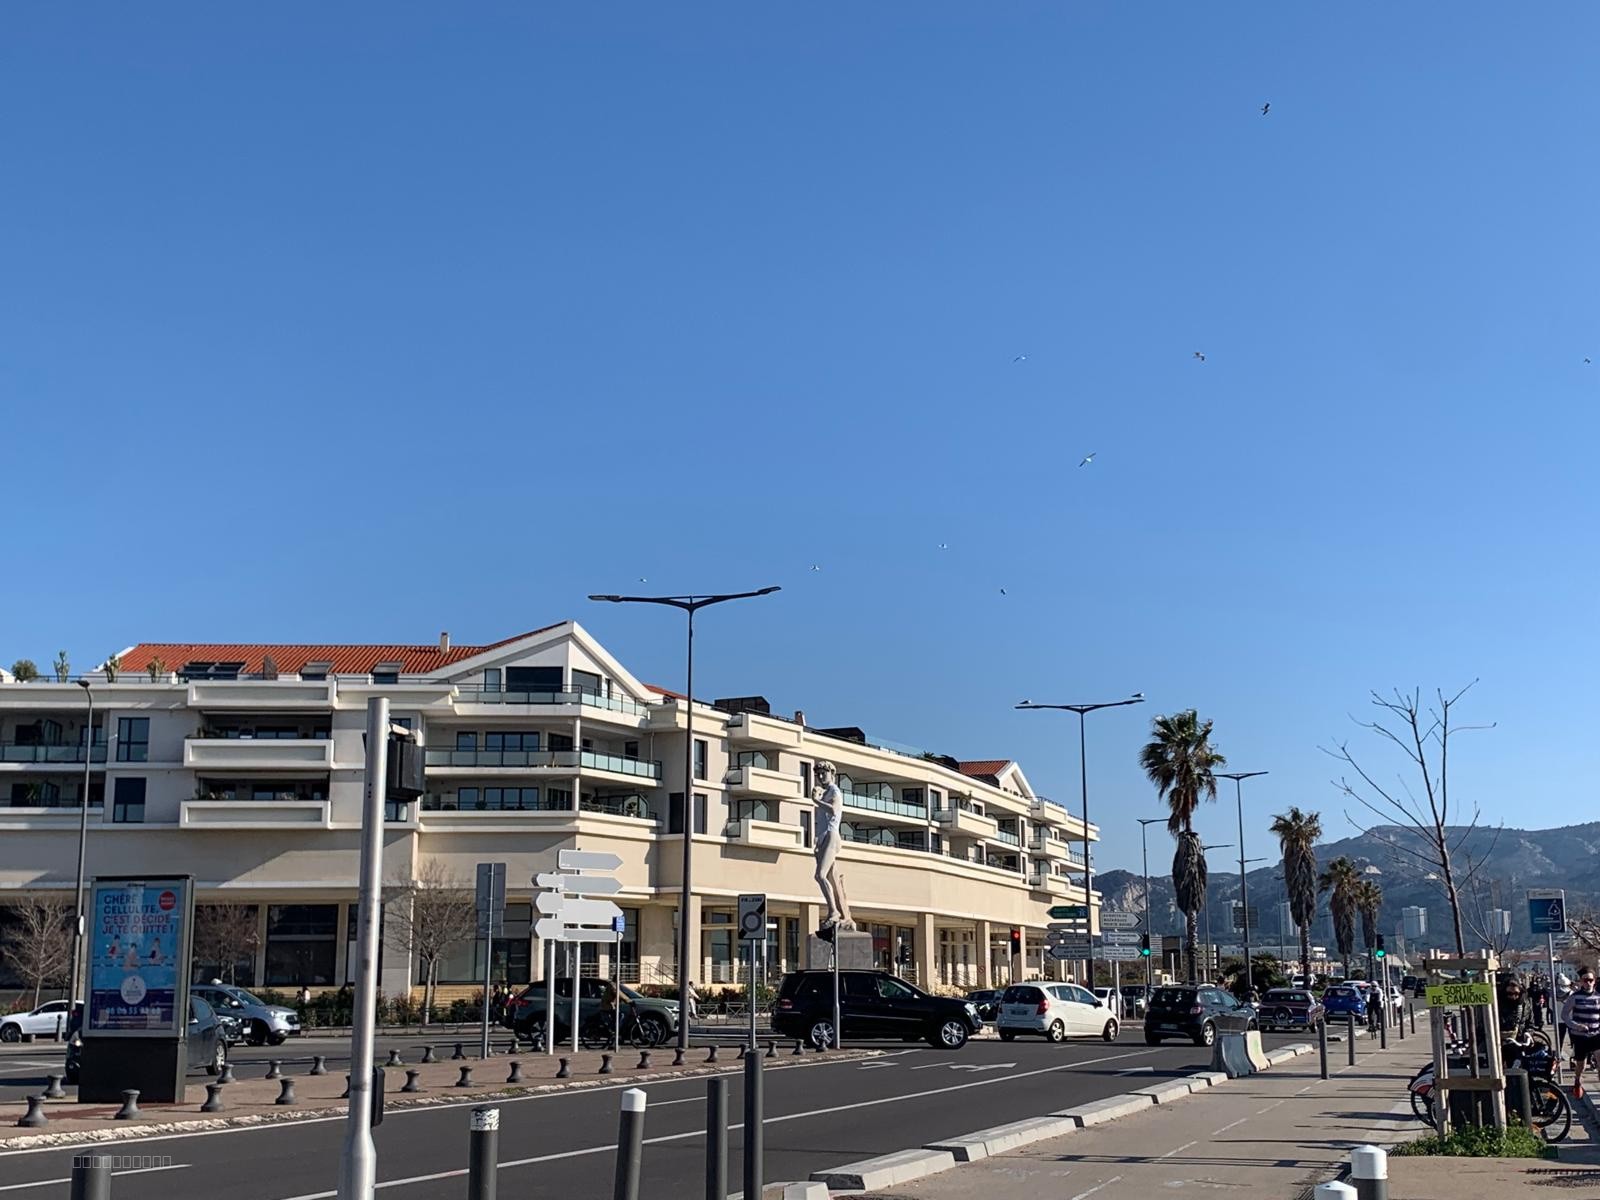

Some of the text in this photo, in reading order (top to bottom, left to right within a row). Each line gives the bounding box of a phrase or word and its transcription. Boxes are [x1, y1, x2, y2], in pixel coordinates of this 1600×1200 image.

[104, 893, 138, 904] CHÈRE
[103, 915, 129, 925] C'EST
[102, 925, 113, 935] JE
[117, 925, 129, 934] TE
[131, 925, 168, 934] QUITTE
[1443, 984, 1474, 996] SORTIE
[1431, 993, 1488, 1005] DE CAMIONS
